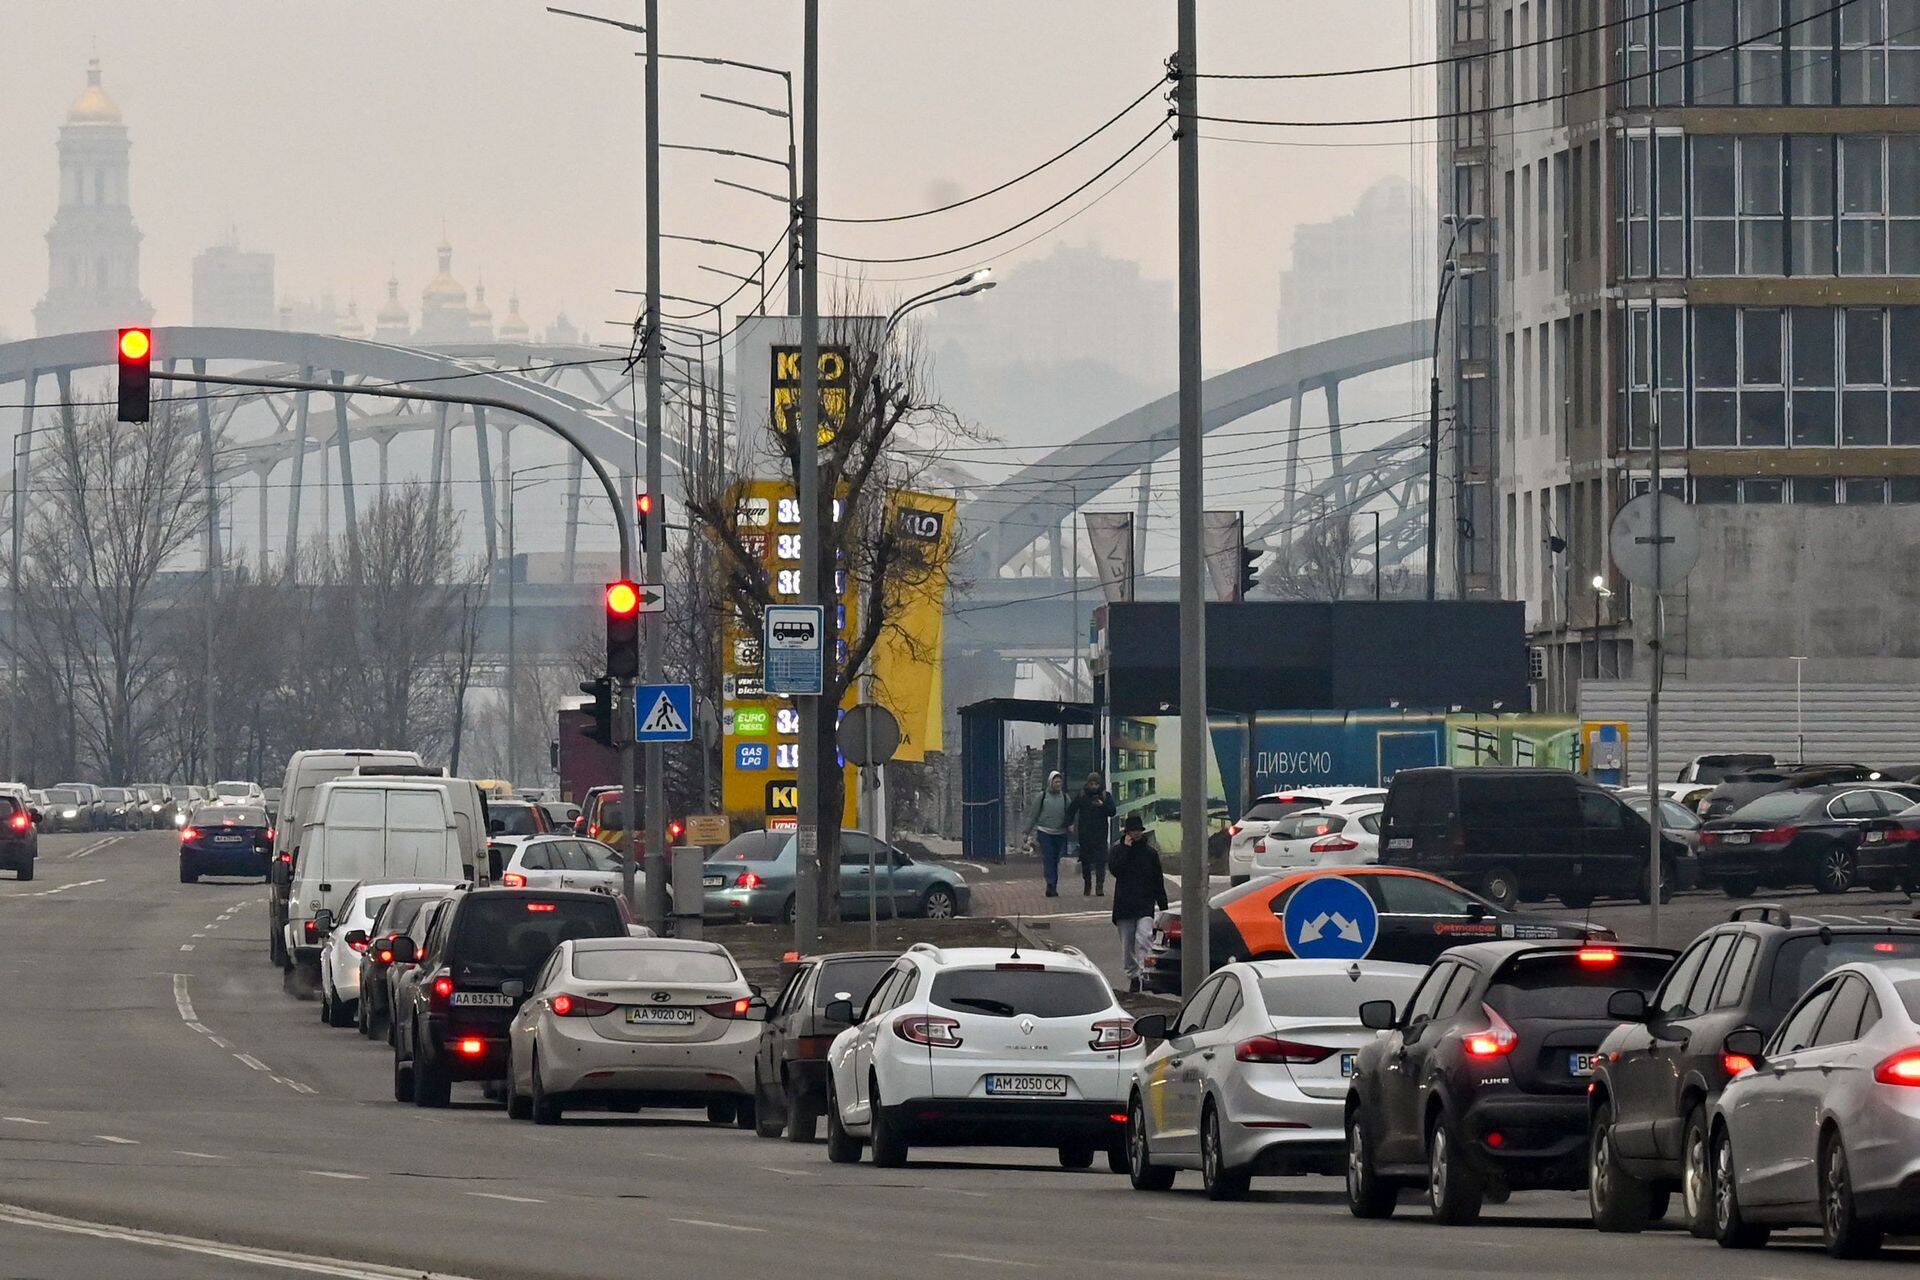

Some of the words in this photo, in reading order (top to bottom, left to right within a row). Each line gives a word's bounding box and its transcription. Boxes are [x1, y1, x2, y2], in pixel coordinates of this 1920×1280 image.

[777, 352, 844, 380] KO
[737, 713, 766, 723] EURO
[739, 723, 764, 731] DIESEL
[741, 747, 762, 756] GAS
[741, 757, 762, 766] LPG
[1256, 751, 1332, 778] ДИВУЄМО
[456, 994, 469, 1004] AA
[471, 994, 494, 1005] 8363
[634, 1010, 648, 1019] AA
[651, 1010, 674, 1020] 9020
[676, 1011, 692, 1020] OM
[995, 1078, 1012, 1090] AM
[1015, 1079, 1042, 1090] 2050
[1045, 1079, 1061, 1090] CK
[1480, 1077, 1510, 1085] JUKE
